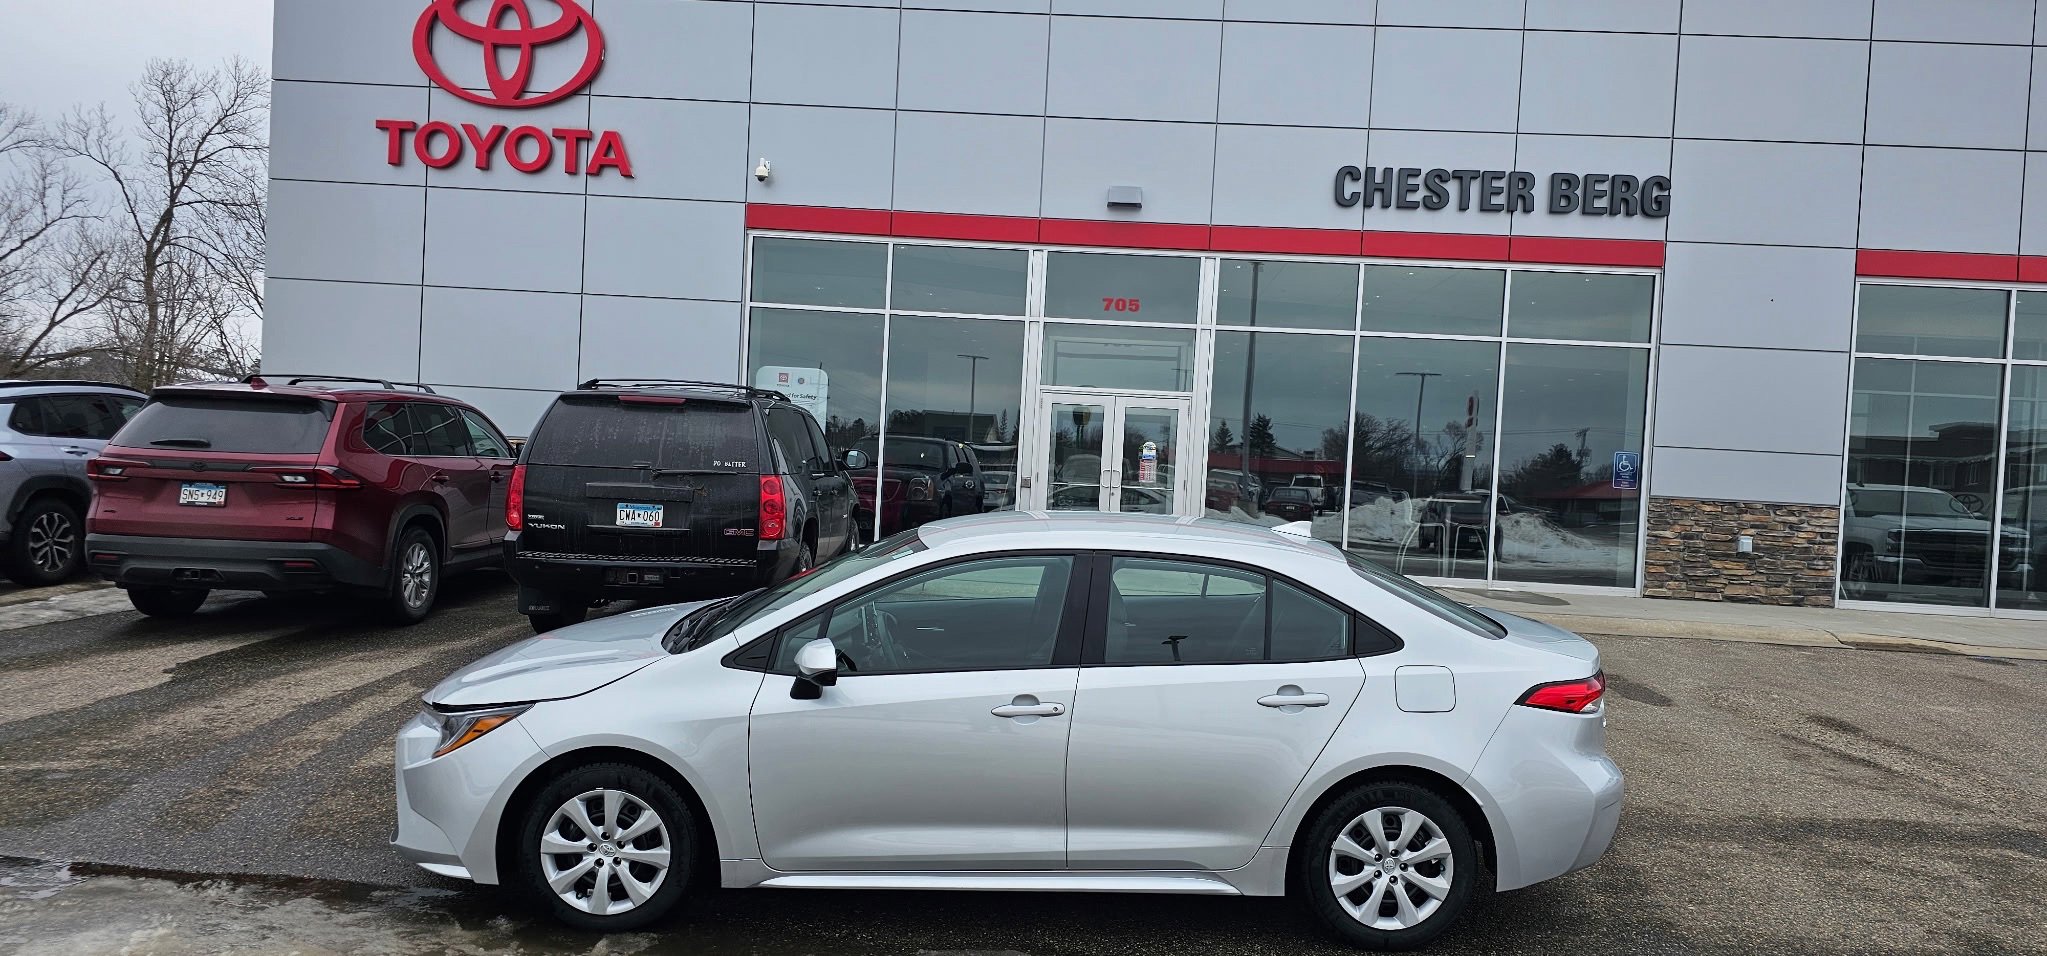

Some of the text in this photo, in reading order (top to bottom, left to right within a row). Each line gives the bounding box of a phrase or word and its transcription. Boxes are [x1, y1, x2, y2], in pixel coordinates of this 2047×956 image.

[376, 119, 635, 178] TOYOTA
[1335, 165, 1672, 218] CHESTER BERG
[1103, 297, 1141, 313] 705
[528, 522, 566, 530] YUKON
[723, 528, 755, 537] GMC
